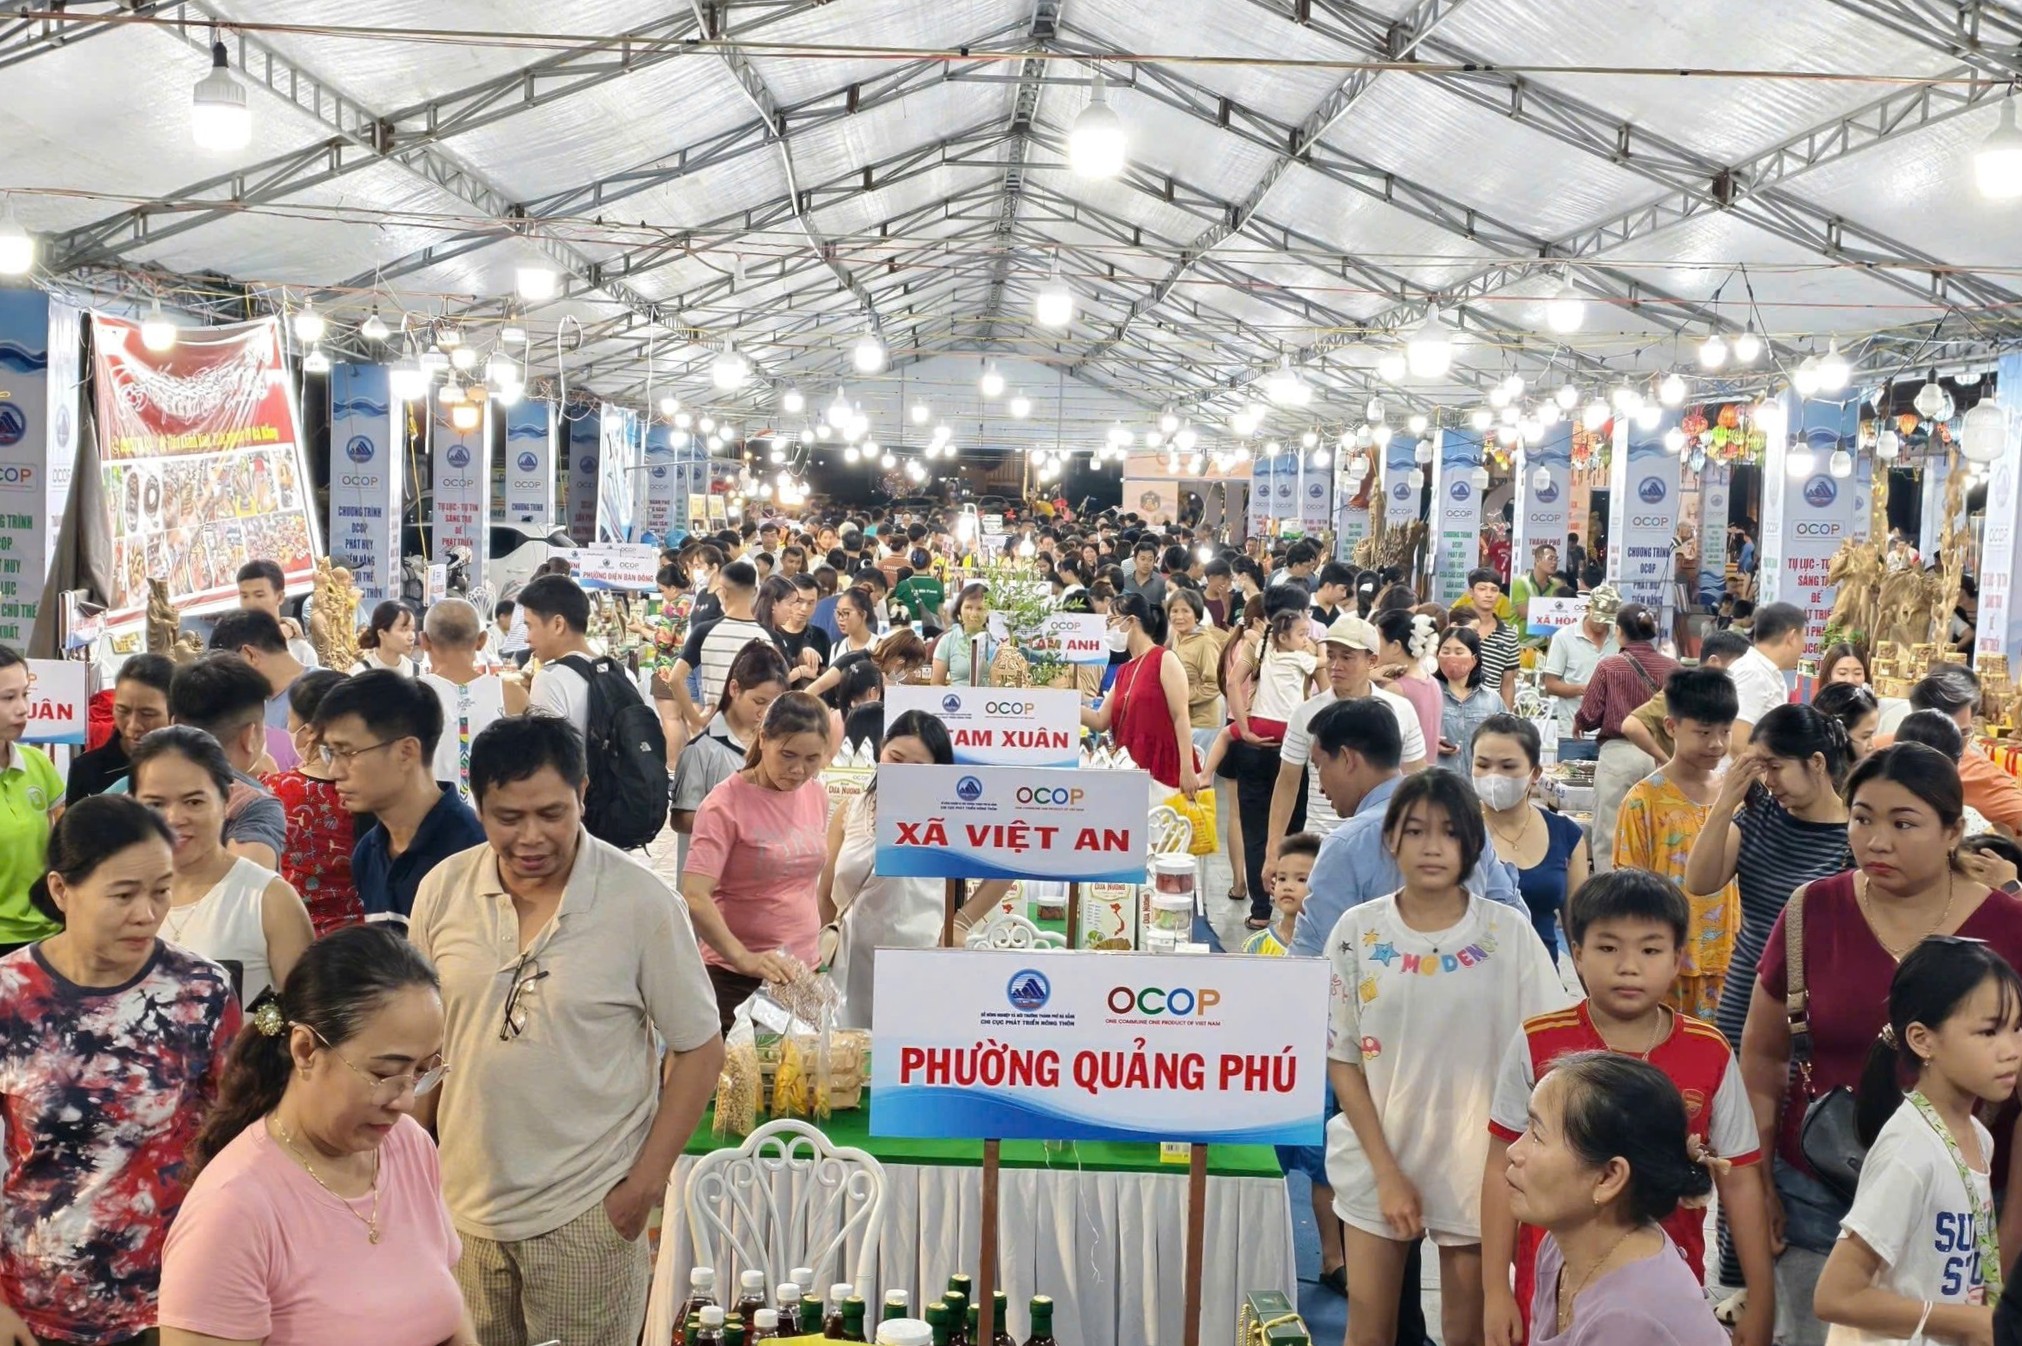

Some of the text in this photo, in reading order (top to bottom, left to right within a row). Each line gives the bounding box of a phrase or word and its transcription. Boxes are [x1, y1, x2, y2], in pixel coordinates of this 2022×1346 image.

[0, 467, 32, 482] OP
[342, 475, 378, 486] OCOP
[443, 478, 474, 487] OCOP
[1632, 516, 1668, 526] OCOP
[1797, 523, 1840, 535] OCOP
[0, 536, 12, 550] OP
[620, 561, 639, 569] OCOP
[1640, 563, 1656, 574] OCOP
[1798, 574, 1819, 586] SÁNG
[1050, 621, 1081, 630] OCOP
[1067, 640, 1100, 651] ANH
[985, 701, 1035, 715] OCOP
[1002, 726, 1069, 749] XUÂN
[1016, 786, 1084, 806] OCOP
[895, 817, 1131, 854] XÃ VIỆT AN
[1108, 986, 1221, 1016] OCOP
[900, 1037, 1297, 1094] PHƯỜNG QUẢNG PHÚ
